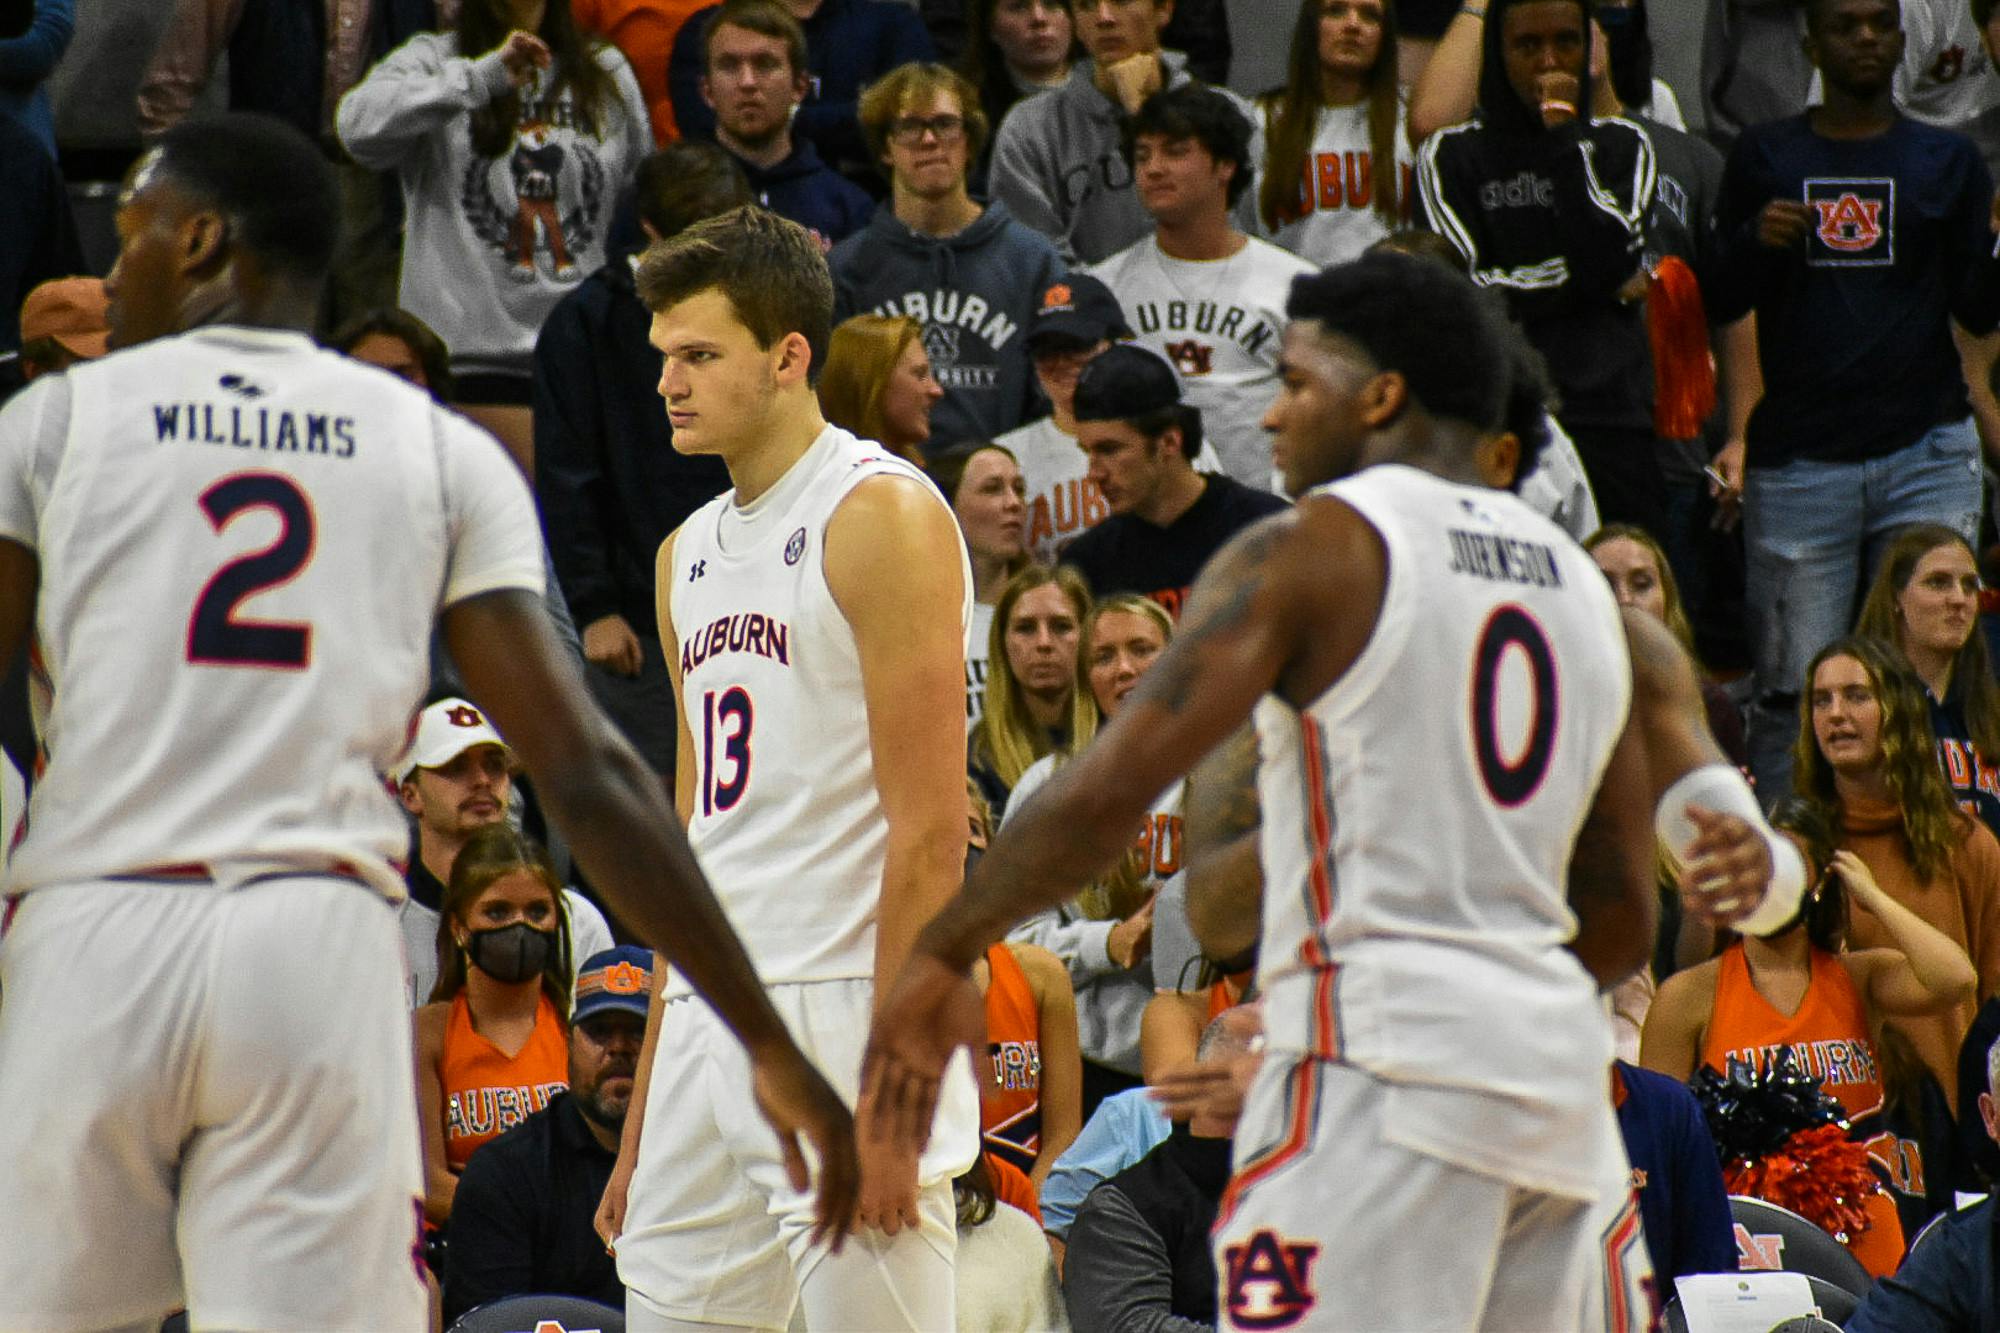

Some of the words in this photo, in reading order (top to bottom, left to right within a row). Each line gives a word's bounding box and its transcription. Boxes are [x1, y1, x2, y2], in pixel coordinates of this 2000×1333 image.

[1816, 192, 1884, 250] AU
[1136, 300, 1273, 355] UBURN
[154, 402, 356, 458] WILLIAMS
[1029, 477, 1107, 548] AUB
[187, 467, 317, 671] 2
[1448, 527, 1564, 589] JOHNSON
[681, 611, 791, 684] AUBURN
[1469, 602, 1561, 808] 0
[701, 686, 754, 818] 13
[1222, 1226, 1321, 1331] AU
